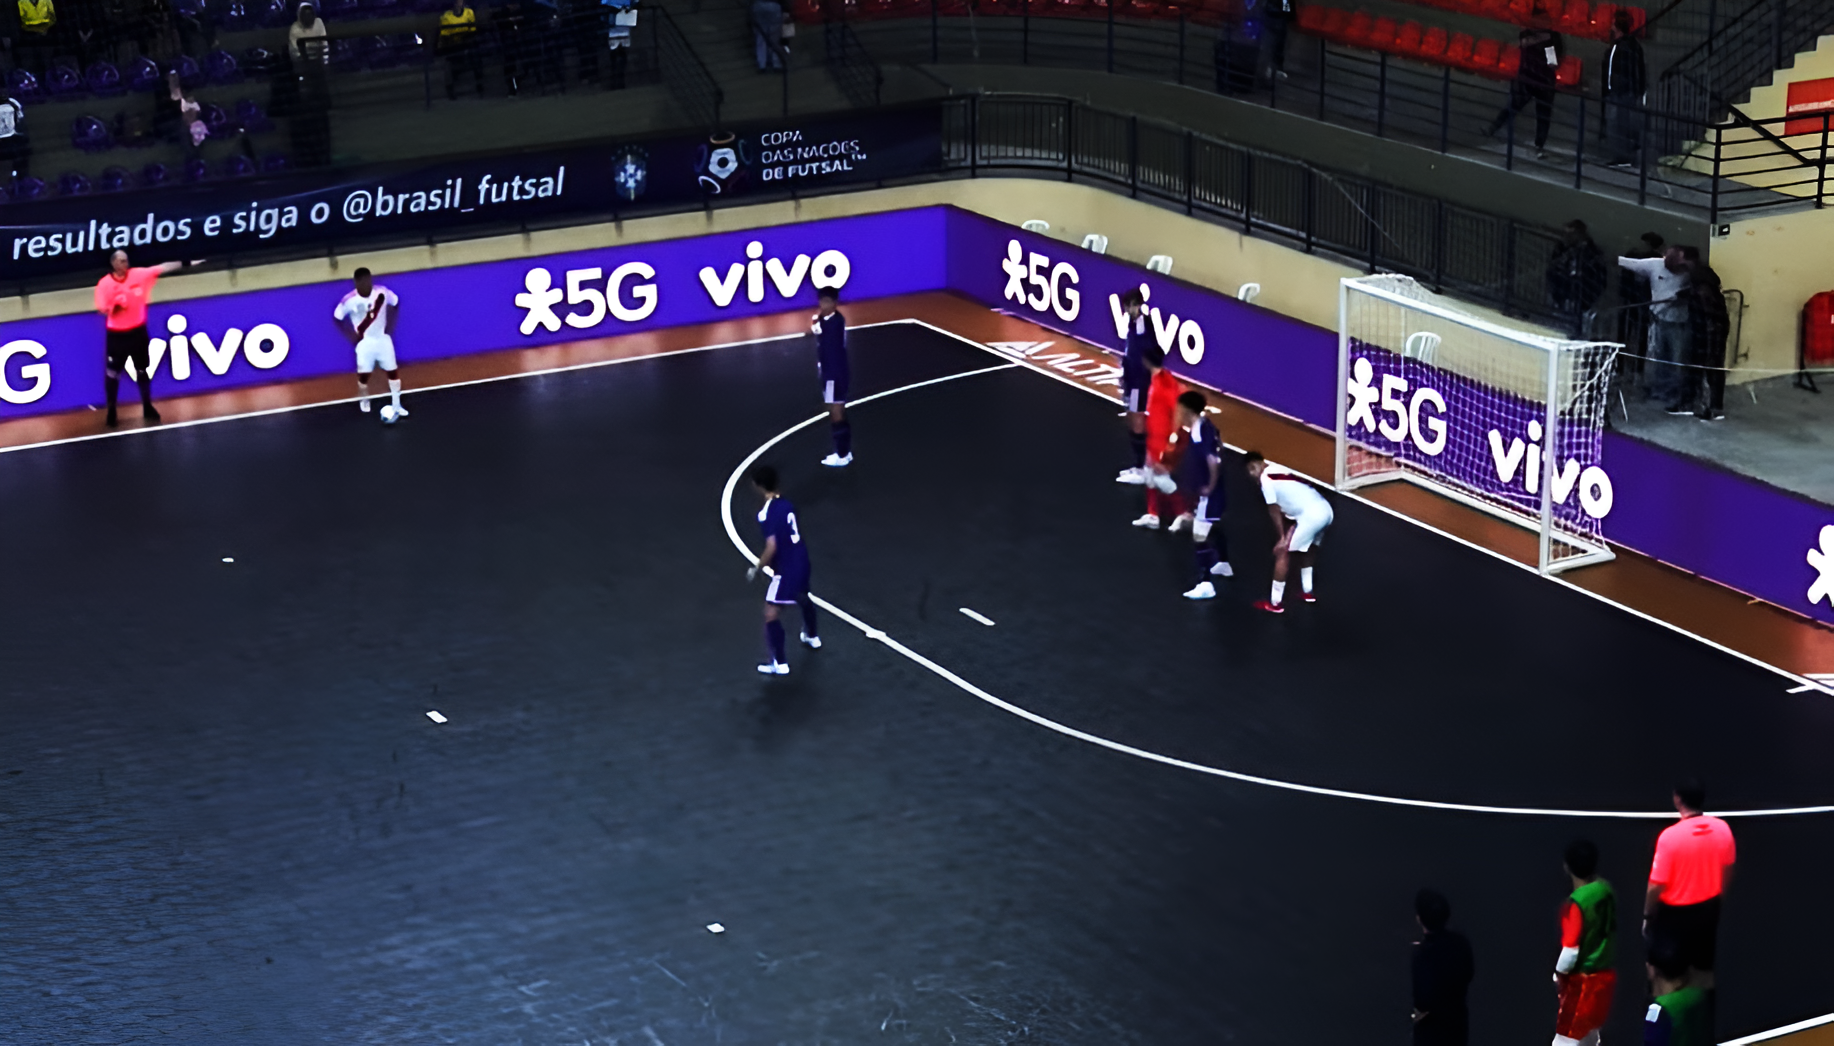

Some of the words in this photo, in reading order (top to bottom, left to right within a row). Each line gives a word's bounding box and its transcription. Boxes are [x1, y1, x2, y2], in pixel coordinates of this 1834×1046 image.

[761, 130, 803, 146] COPA
[762, 166, 784, 181] DE
[12, 212, 192, 260] resultados
[203, 215, 221, 236] e
[232, 201, 299, 238] siga
[310, 202, 330, 224] o
[343, 165, 565, 222] @brasil_futsal
[565, 261, 658, 329] 5G
[698, 240, 851, 307] vivo
[1027, 251, 1081, 322] 5G
[1378, 373, 1447, 456] 5G
